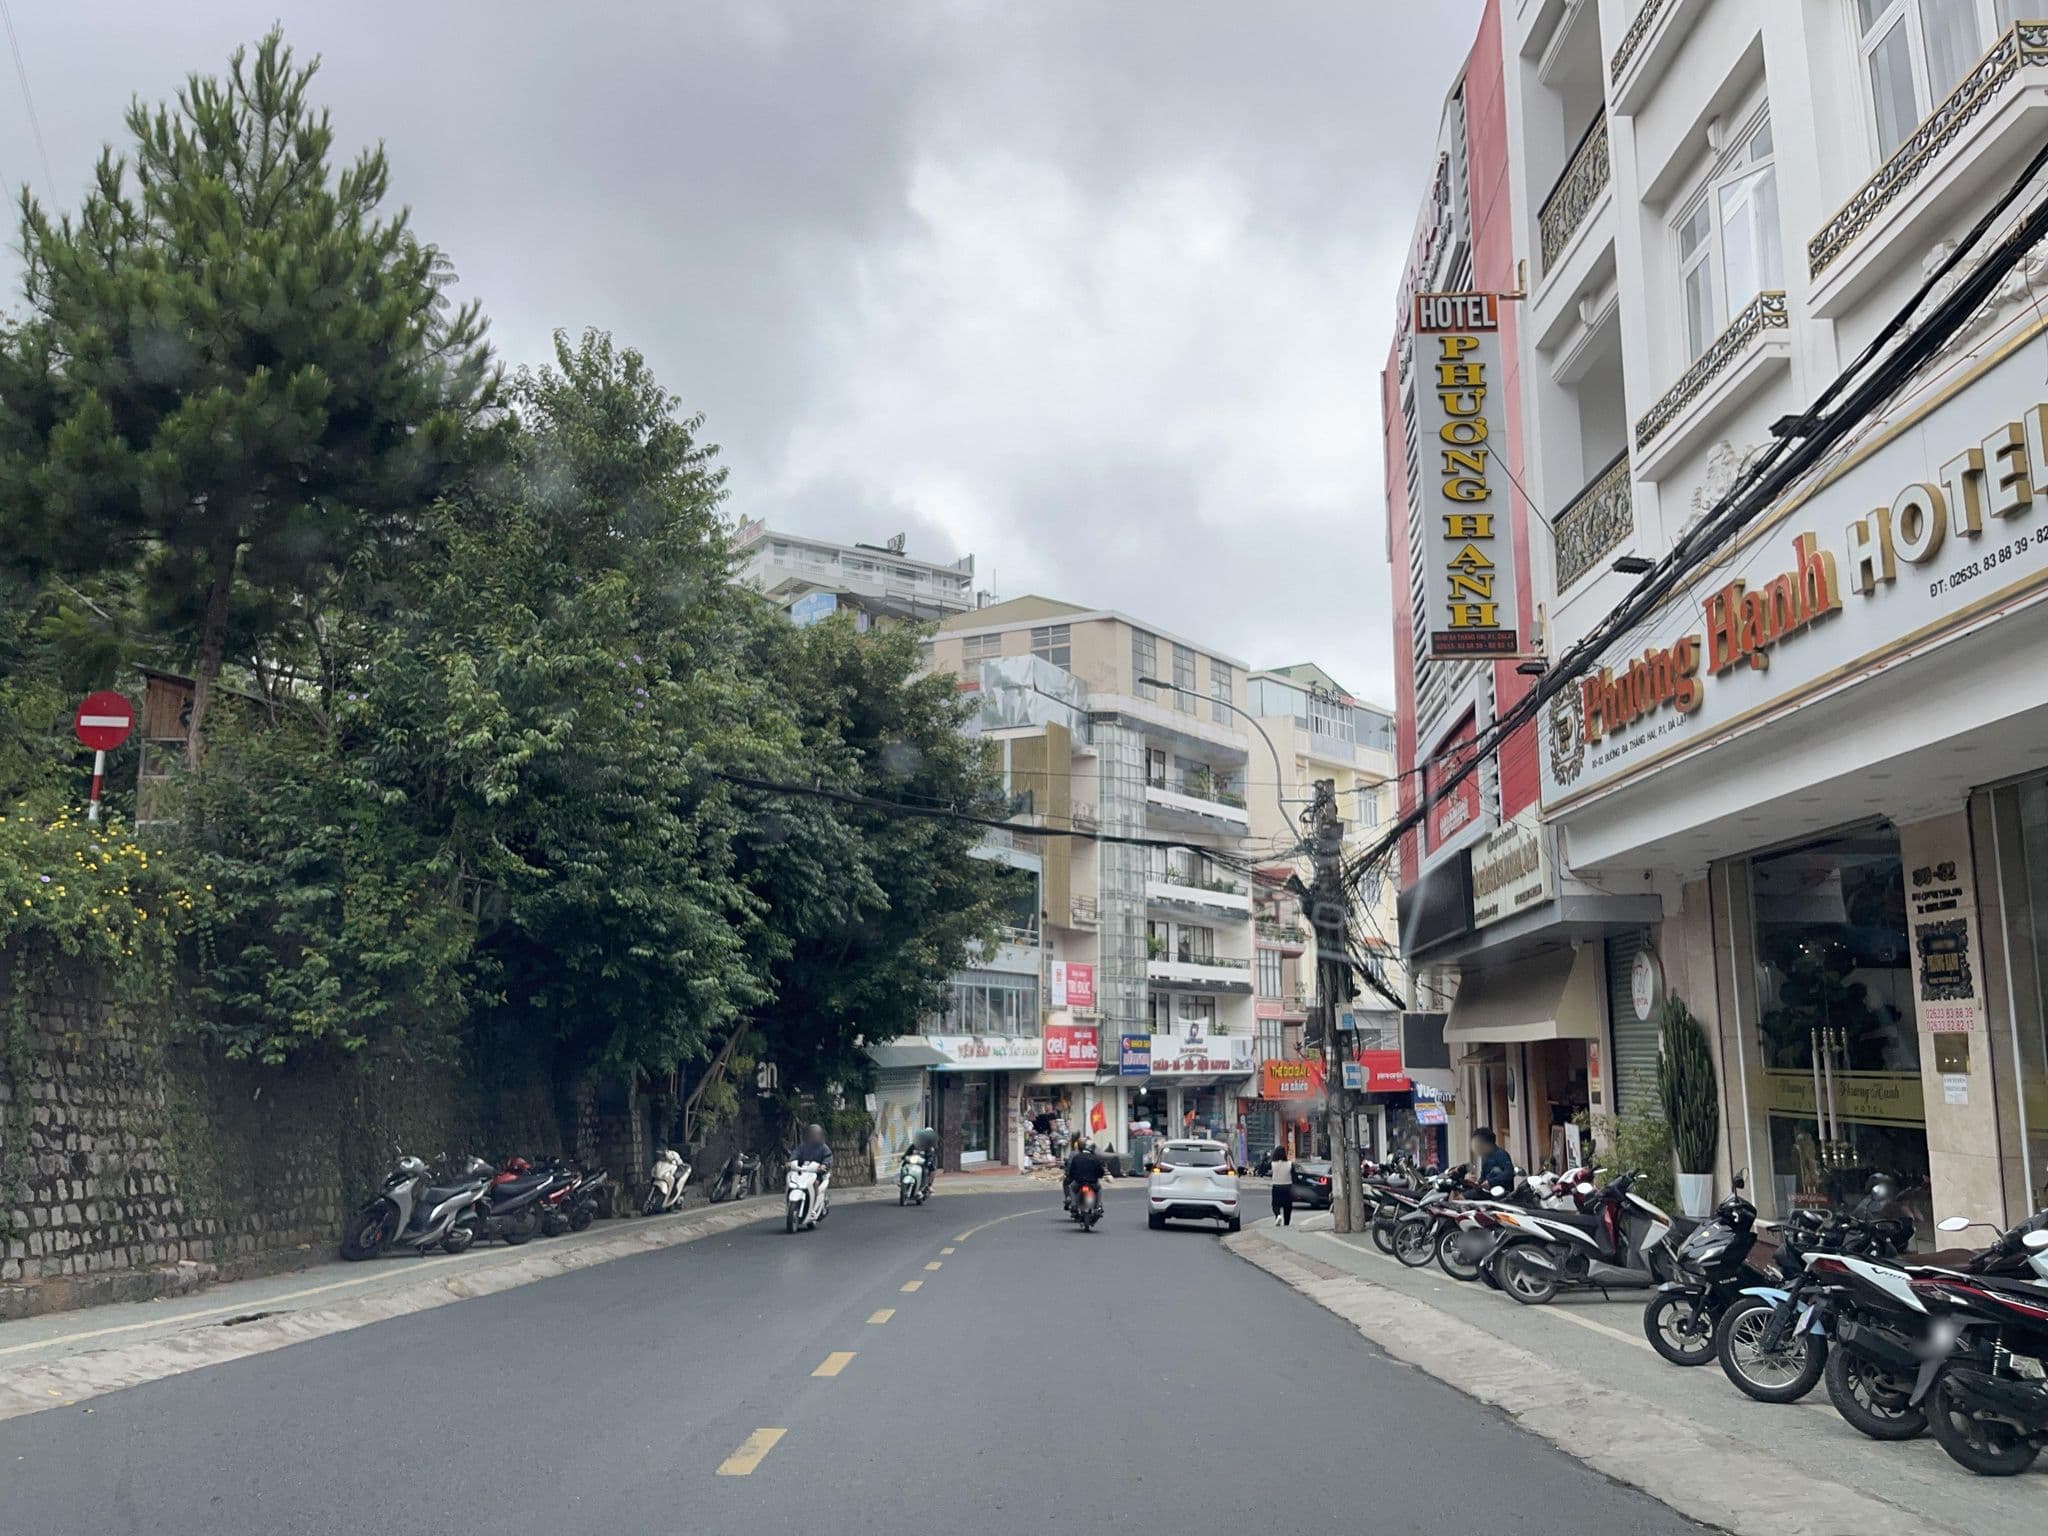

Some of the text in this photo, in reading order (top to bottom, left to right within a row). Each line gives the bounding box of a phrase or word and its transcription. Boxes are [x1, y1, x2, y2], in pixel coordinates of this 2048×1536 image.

[1419, 296, 1497, 329] HOTEL
[1435, 335, 1500, 628] PHƯƠNG HẠNH
[1846, 404, 2048, 594] HOTEL
[1983, 553, 1996, 571] 83
[1998, 545, 2012, 563] 88
[2014, 537, 2028, 555] 39
[1581, 531, 1842, 744] Phương Hạnh
[1047, 1037, 1067, 1054] deli
[1853, 1104, 1885, 1114] HOTEL
